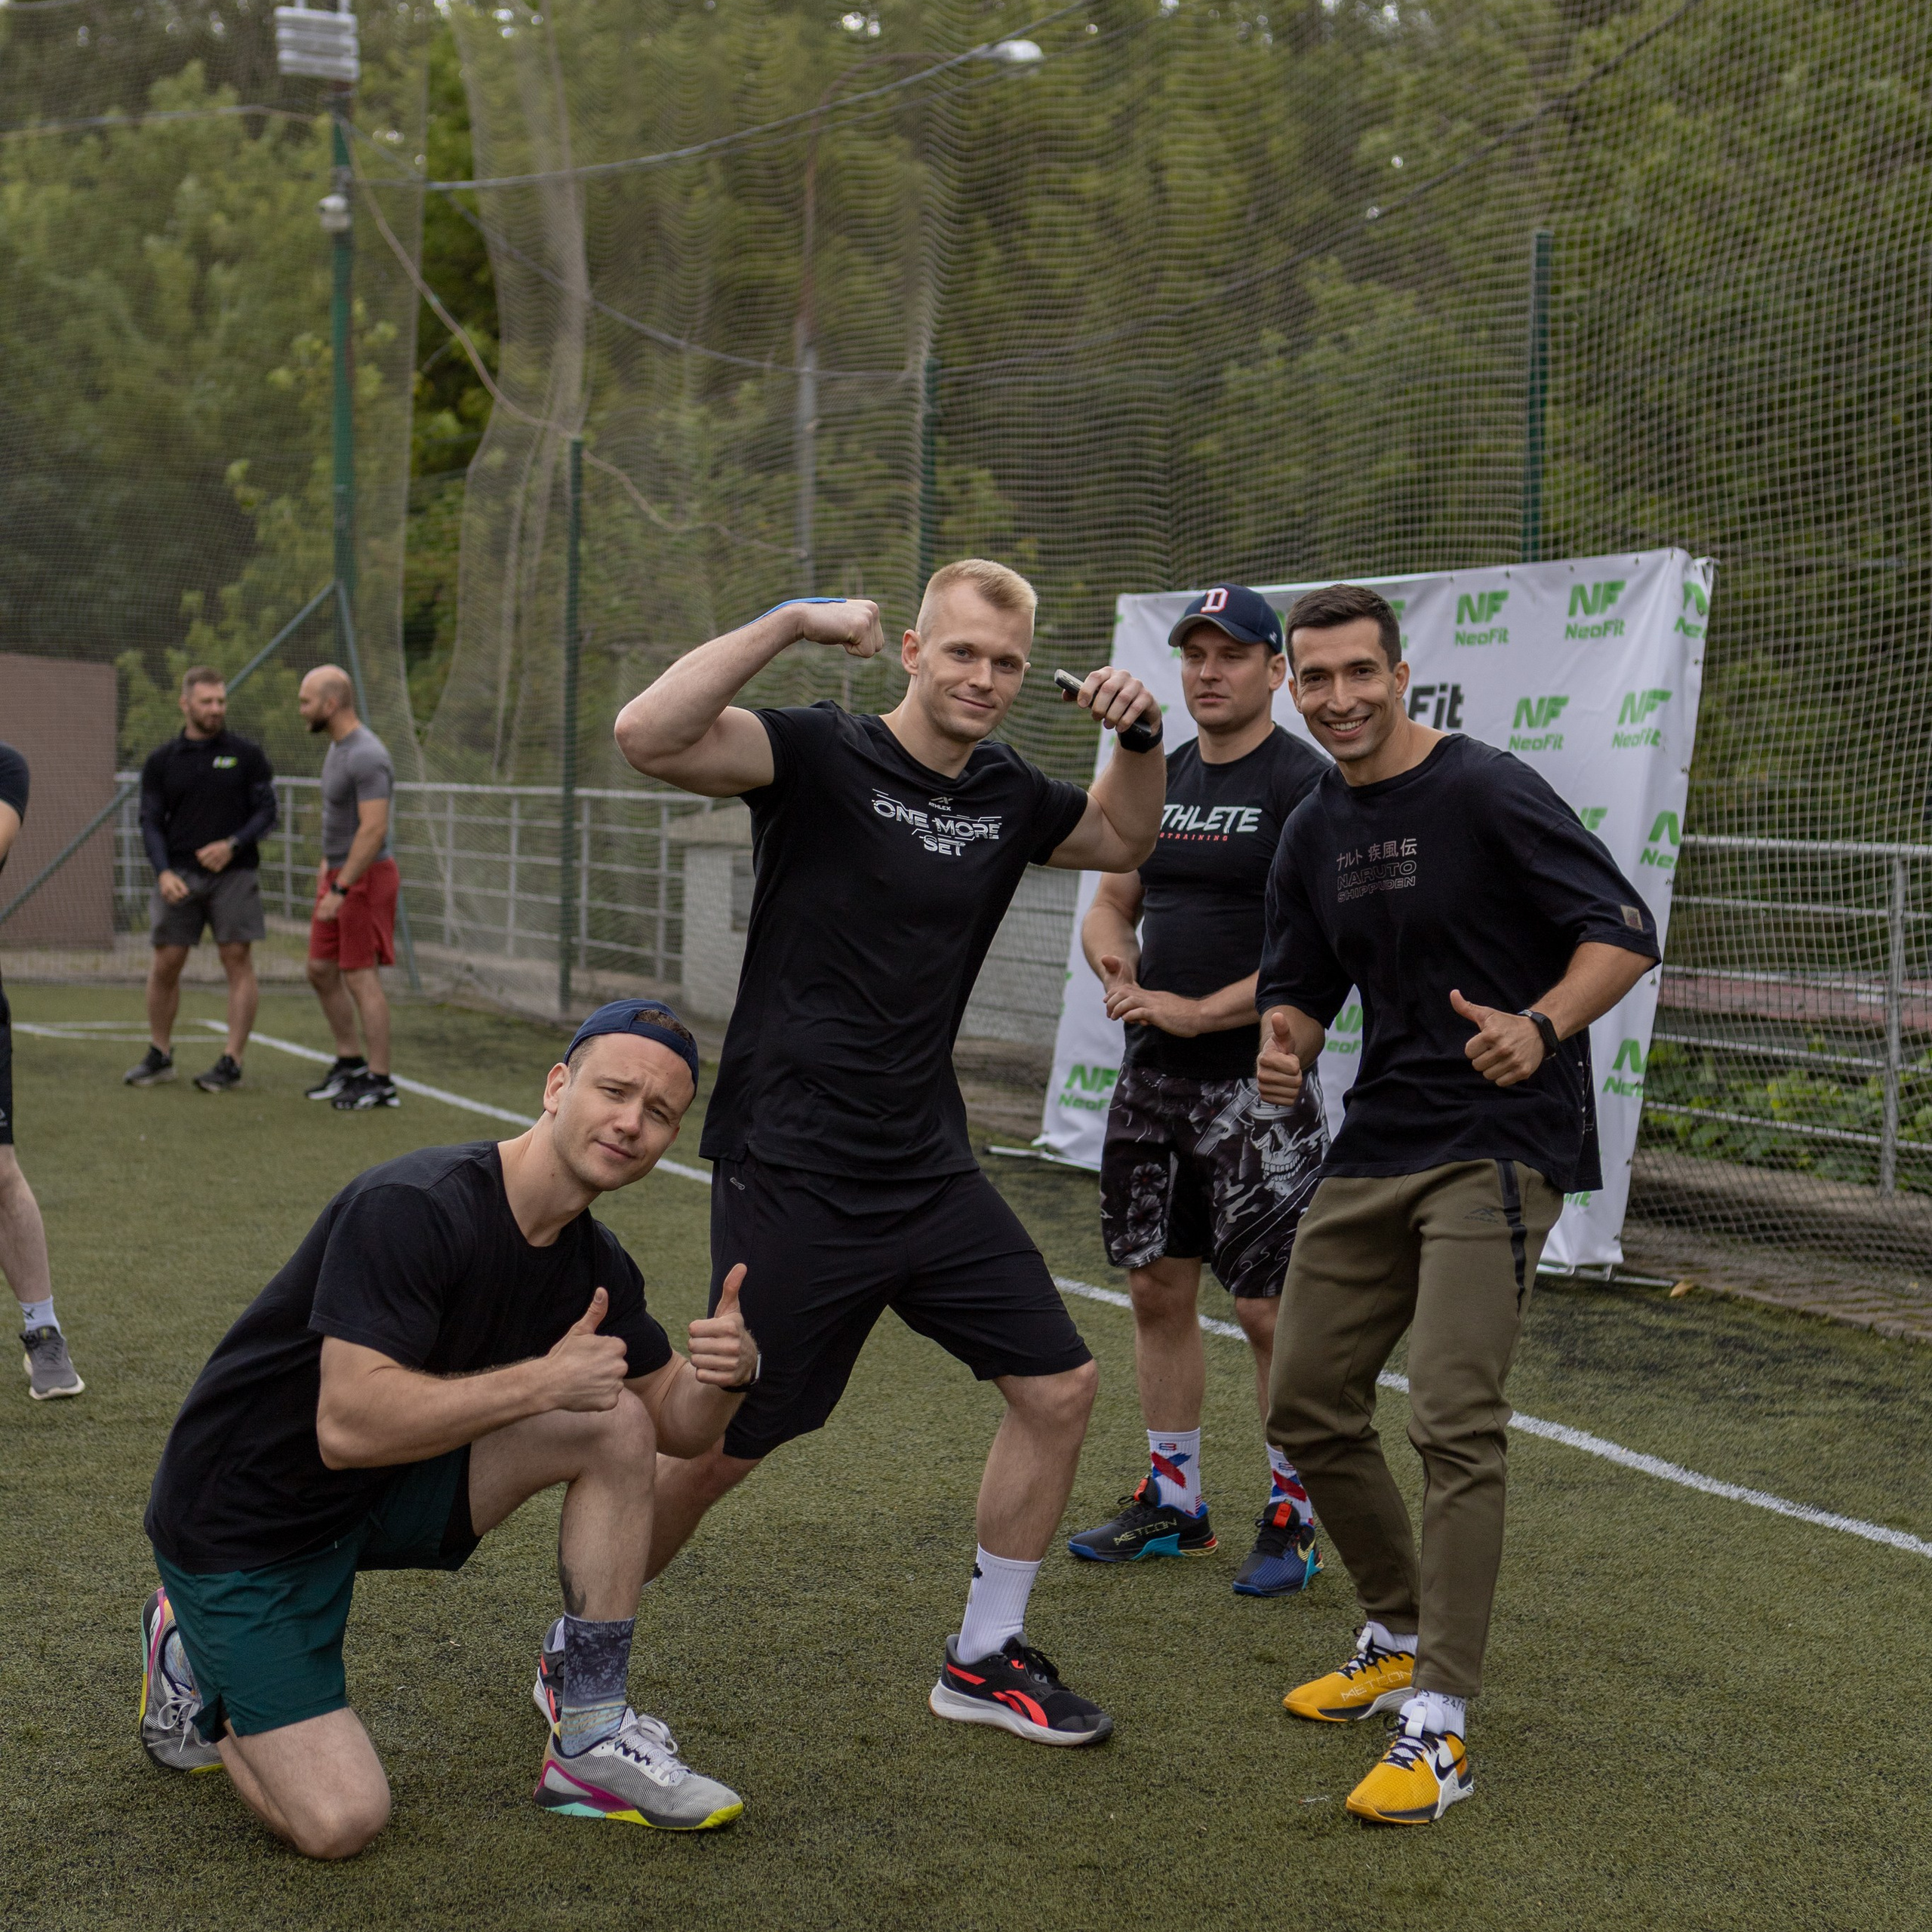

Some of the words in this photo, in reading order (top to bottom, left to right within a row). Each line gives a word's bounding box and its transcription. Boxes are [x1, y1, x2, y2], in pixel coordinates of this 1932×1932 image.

[1200, 587, 1229, 614] D
[1456, 589, 1509, 626] NF
[1568, 580, 1626, 617] NF
[1454, 626, 1509, 648] NeoFit
[1564, 618, 1626, 641] NeoFit
[1403, 682, 1465, 731] Fit
[1512, 695, 1570, 730] NF
[1617, 688, 1673, 726] NF
[1508, 733, 1564, 752] NeoFit
[1611, 728, 1662, 749] NeoFit
[873, 799, 930, 829] ONE
[933, 817, 1001, 839] MORE
[1159, 804, 1263, 834] THLETE
[922, 834, 966, 857] SET
[1337, 860, 1417, 891] NARUTO
[1337, 875, 1416, 903] SHIPPUDEN
[1064, 1063, 1119, 1093] NF
[1058, 1093, 1111, 1112] NeoF
[1442, 1695, 1466, 1712] 24/7
